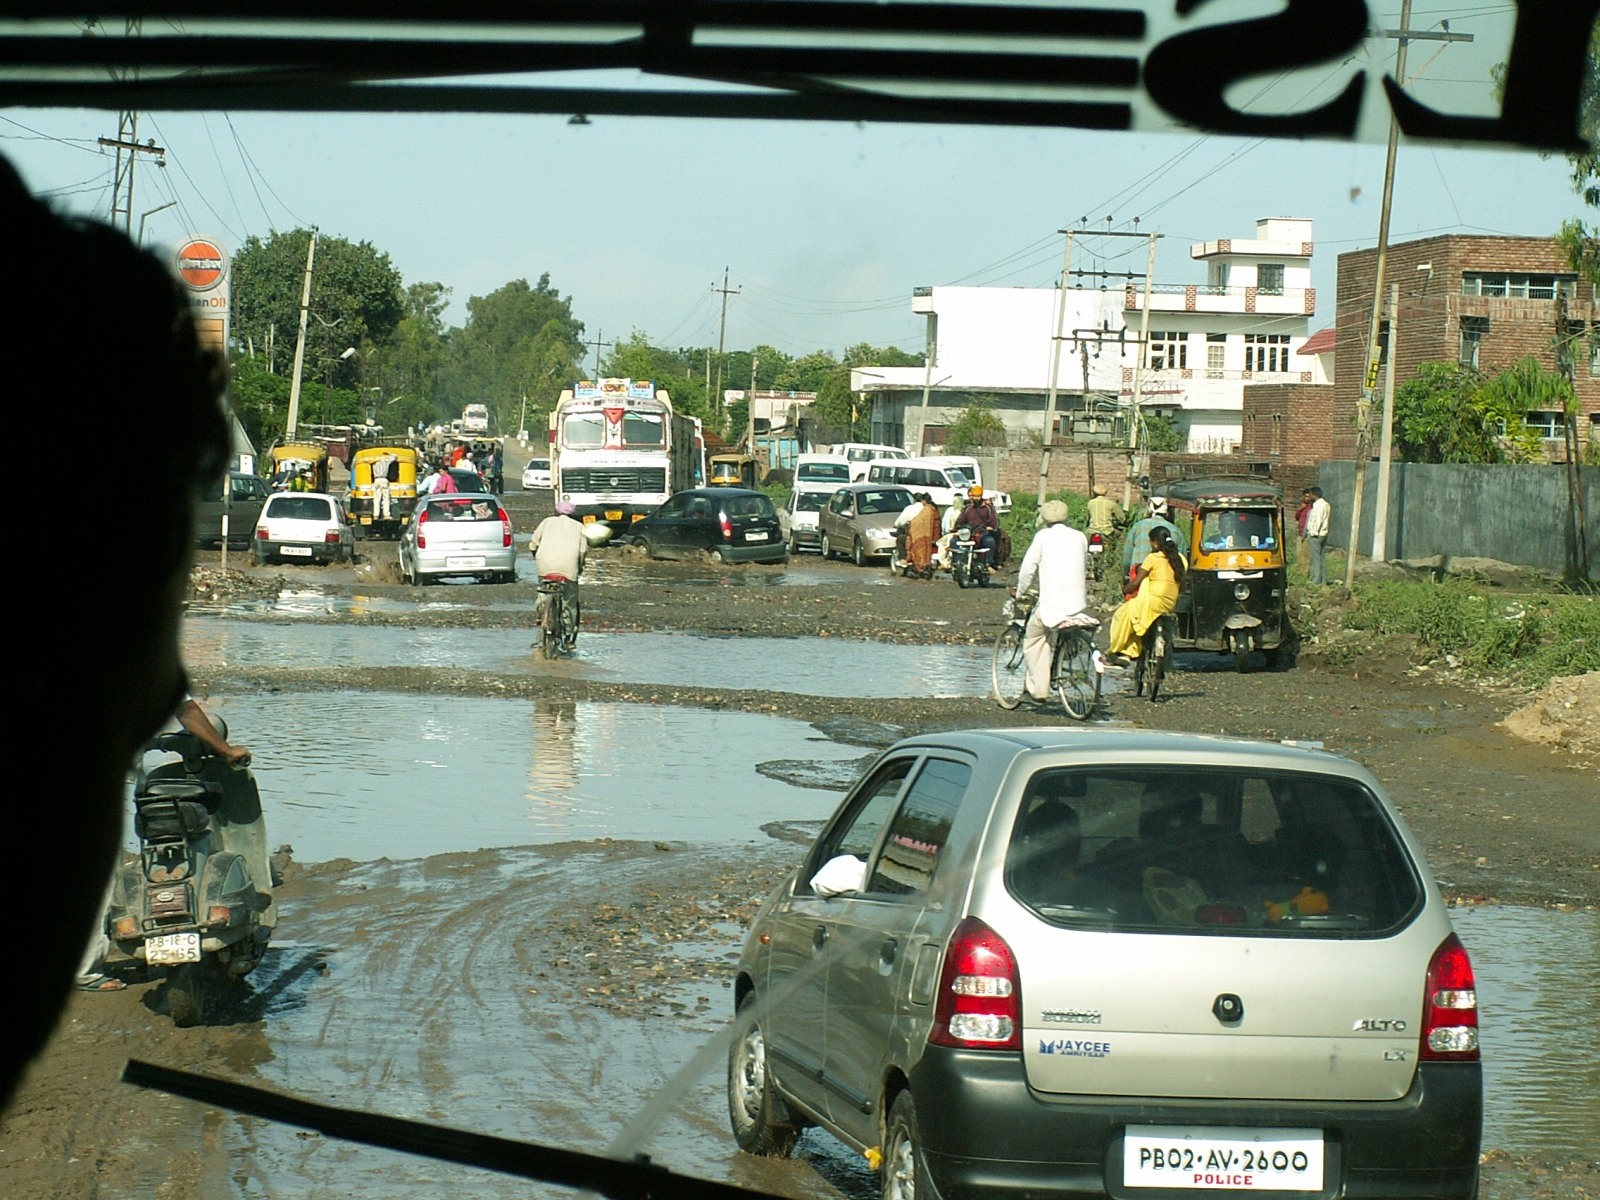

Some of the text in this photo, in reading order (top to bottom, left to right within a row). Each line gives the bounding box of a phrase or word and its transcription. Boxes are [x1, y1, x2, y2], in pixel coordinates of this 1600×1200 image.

[1352, 1018, 1407, 1032] ALTO
[1056, 1039, 1111, 1053] JAYCEE
[1060, 1050, 1105, 1058] AMRITSAR
[1383, 1050, 1406, 1062] LX
[1193, 1173, 1253, 1186] POLICE
